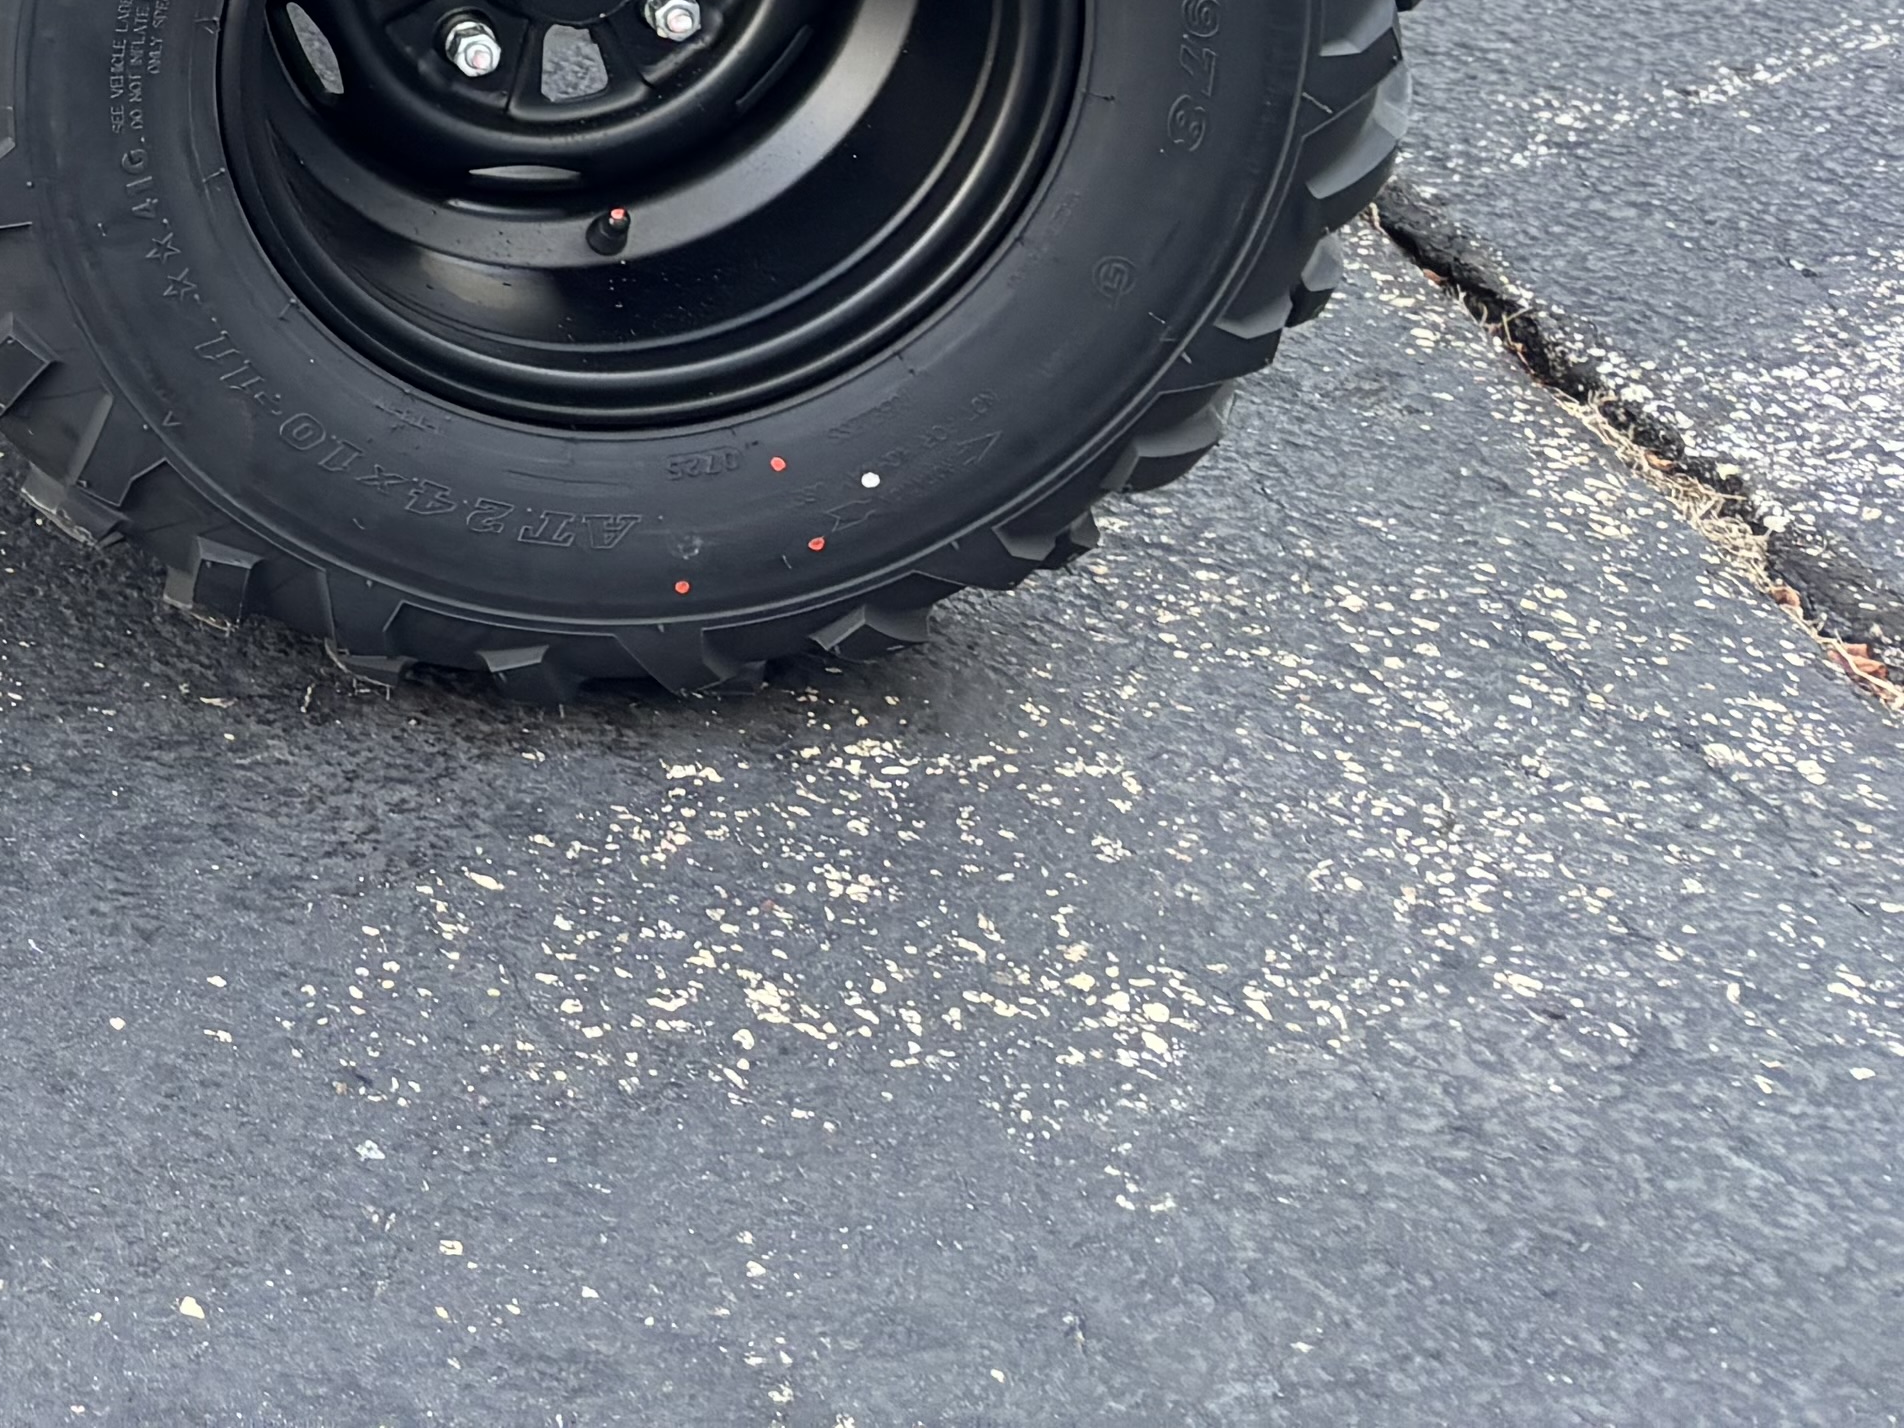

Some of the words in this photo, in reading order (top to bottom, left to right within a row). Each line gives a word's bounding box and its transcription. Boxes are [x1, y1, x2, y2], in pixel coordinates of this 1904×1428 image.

[109, 39, 126, 98] VEHICLE
[128, 74, 142, 102] NOT
[110, 104, 126, 133] SEE
[128, 107, 143, 130] DO
[122, 146, 157, 221] 41G
